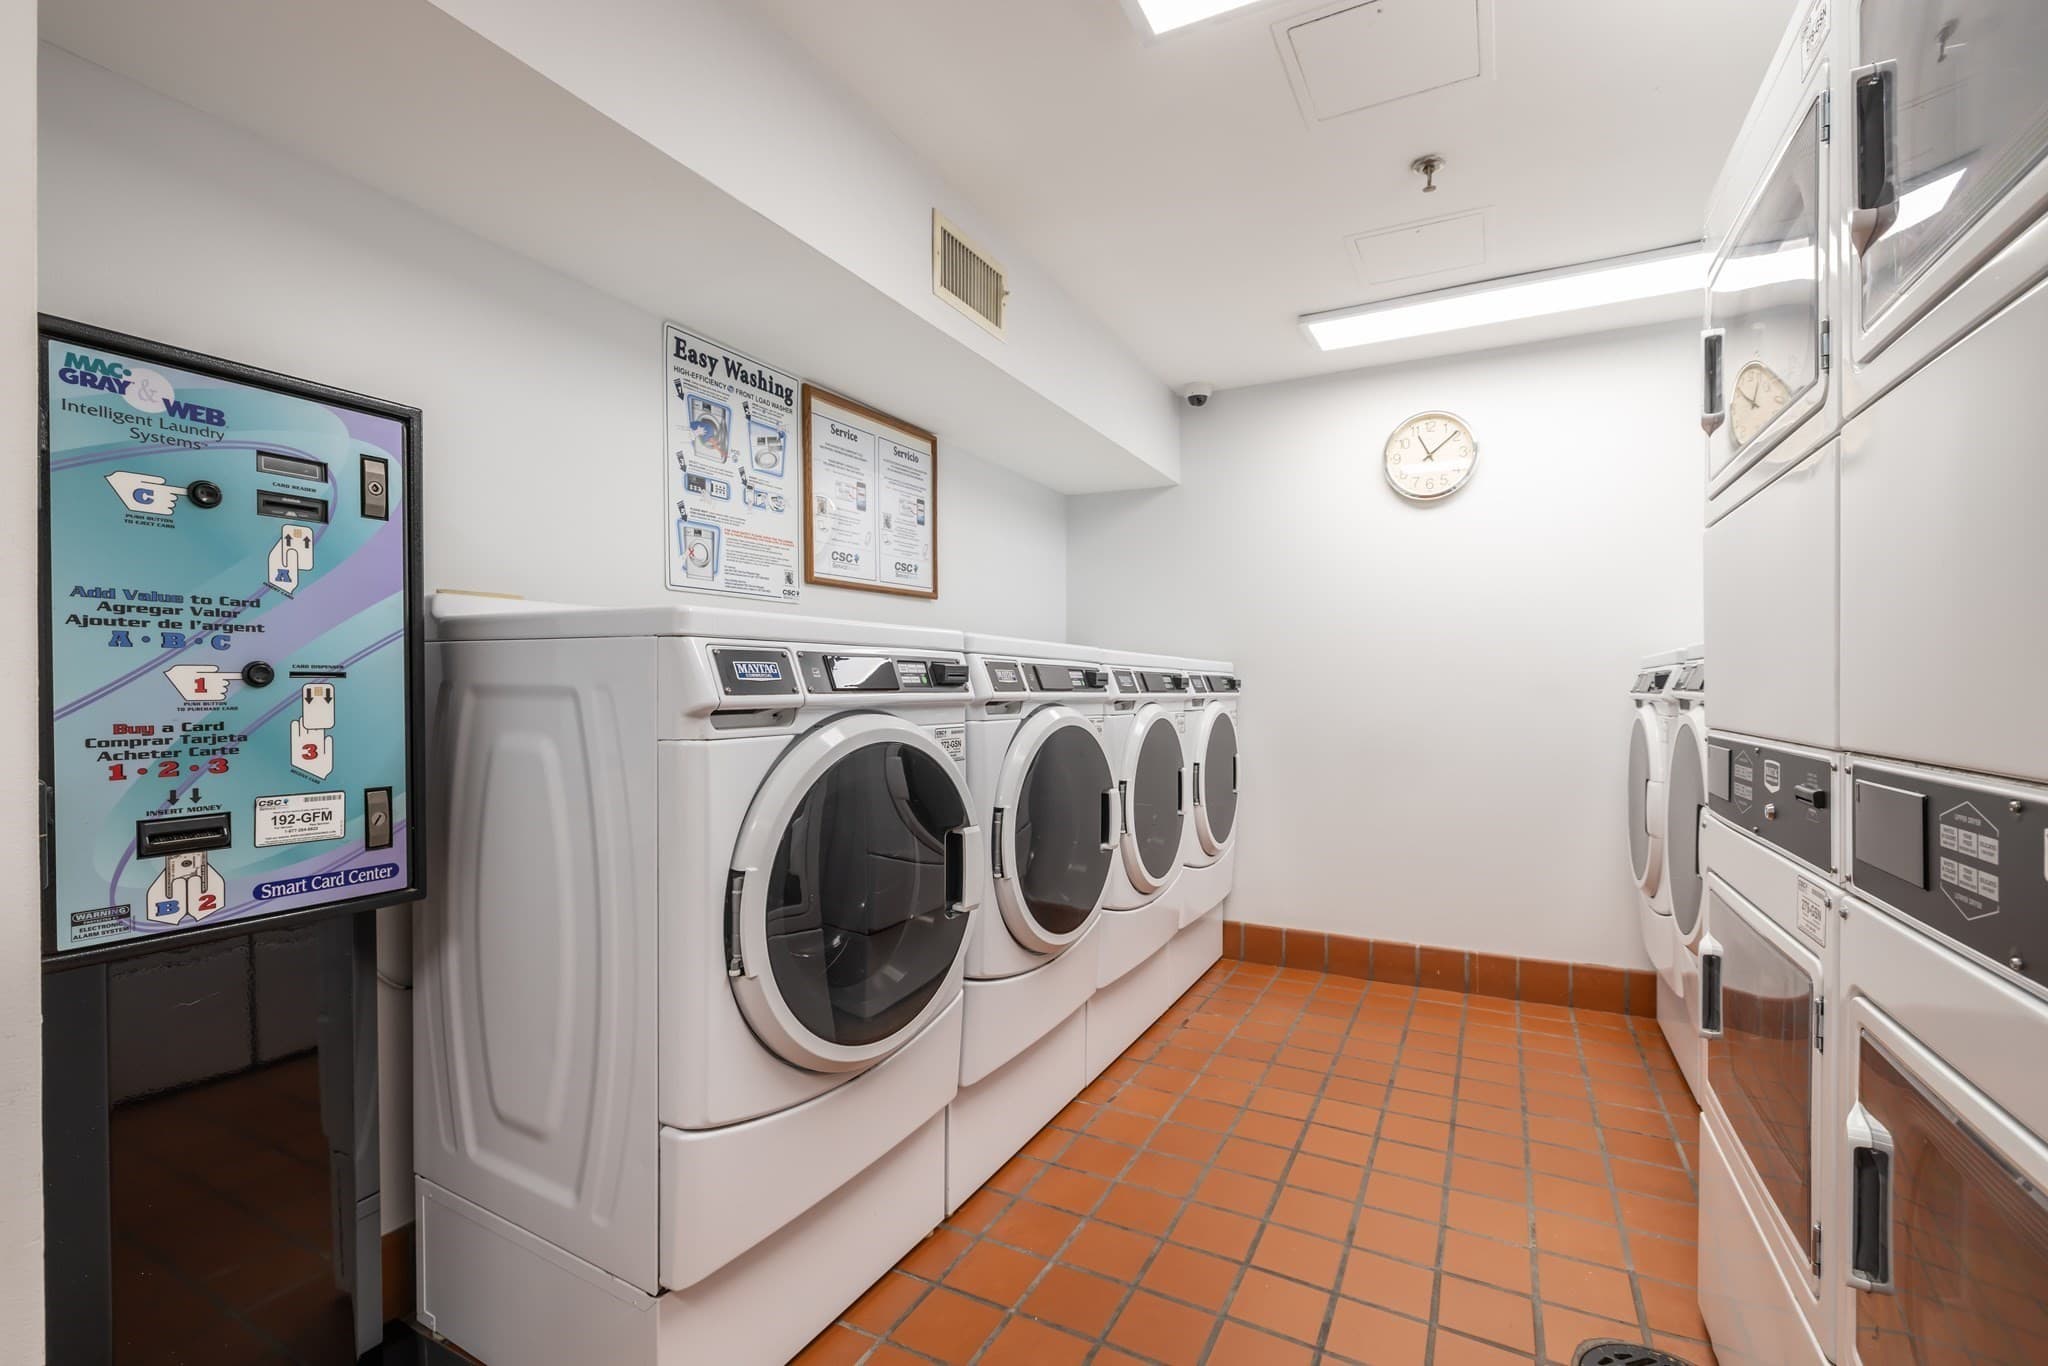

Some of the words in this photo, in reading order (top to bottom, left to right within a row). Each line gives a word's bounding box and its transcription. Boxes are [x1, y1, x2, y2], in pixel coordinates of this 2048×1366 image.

[674, 336, 719, 377] Easy
[722, 355, 793, 406] Washing
[59, 368, 131, 395] GRAY
[138, 378, 158, 402] &
[162, 398, 226, 427] WEB
[674, 365, 727, 391] HIGH-EFFICIENCY
[735, 388, 754, 401] FRONT
[756, 393, 770, 407] LOAD
[771, 399, 793, 414] WASHER
[61, 398, 152, 427] Intelligent
[160, 418, 225, 442] Laundry
[130, 427, 200, 450] Systems
[830, 423, 859, 442] Service
[893, 446, 920, 464] Servicio
[272, 481, 290, 489] CARD
[133, 488, 154, 505] C
[831, 550, 853, 563] CSC
[275, 568, 292, 583] A
[894, 562, 913, 573] CSC
[69, 585, 116, 600] Add
[123, 589, 184, 604] Value
[190, 594, 213, 606] to
[219, 595, 261, 609] Card
[96, 601, 184, 617] Agregar
[189, 606, 241, 619] Valor
[65, 614, 151, 628] Ajouter
[158, 619, 183, 630] de
[108, 630, 133, 648] A
[160, 631, 186, 649] B
[211, 634, 232, 651] C
[736, 663, 777, 674] MAYTAG
[194, 677, 208, 693] 1
[112, 723, 155, 736] Buy
[161, 725, 174, 733] a
[181, 721, 225, 732] Card
[85, 736, 173, 749] Comprar
[180, 733, 248, 745] Tarjeta
[97, 749, 182, 762] Acheter
[188, 747, 240, 757] Carte
[302, 744, 319, 760] 3
[108, 763, 127, 781] 1
[158, 761, 180, 778] 2
[207, 757, 229, 774] 3
[146, 807, 183, 817] INSERT
[187, 804, 223, 813] MONEY
[259, 799, 282, 807] CSC
[271, 810, 333, 826] 192-GFM
[261, 879, 307, 898] Smart
[311, 870, 345, 890] Card
[349, 866, 393, 883] Center
[75, 907, 126, 920] WARNING
[155, 900, 180, 917] B
[198, 894, 217, 911] 2
[73, 931, 99, 940] ALARM
[101, 926, 129, 935] SYSTEM
[80, 923, 124, 932] ELECTRONIC
